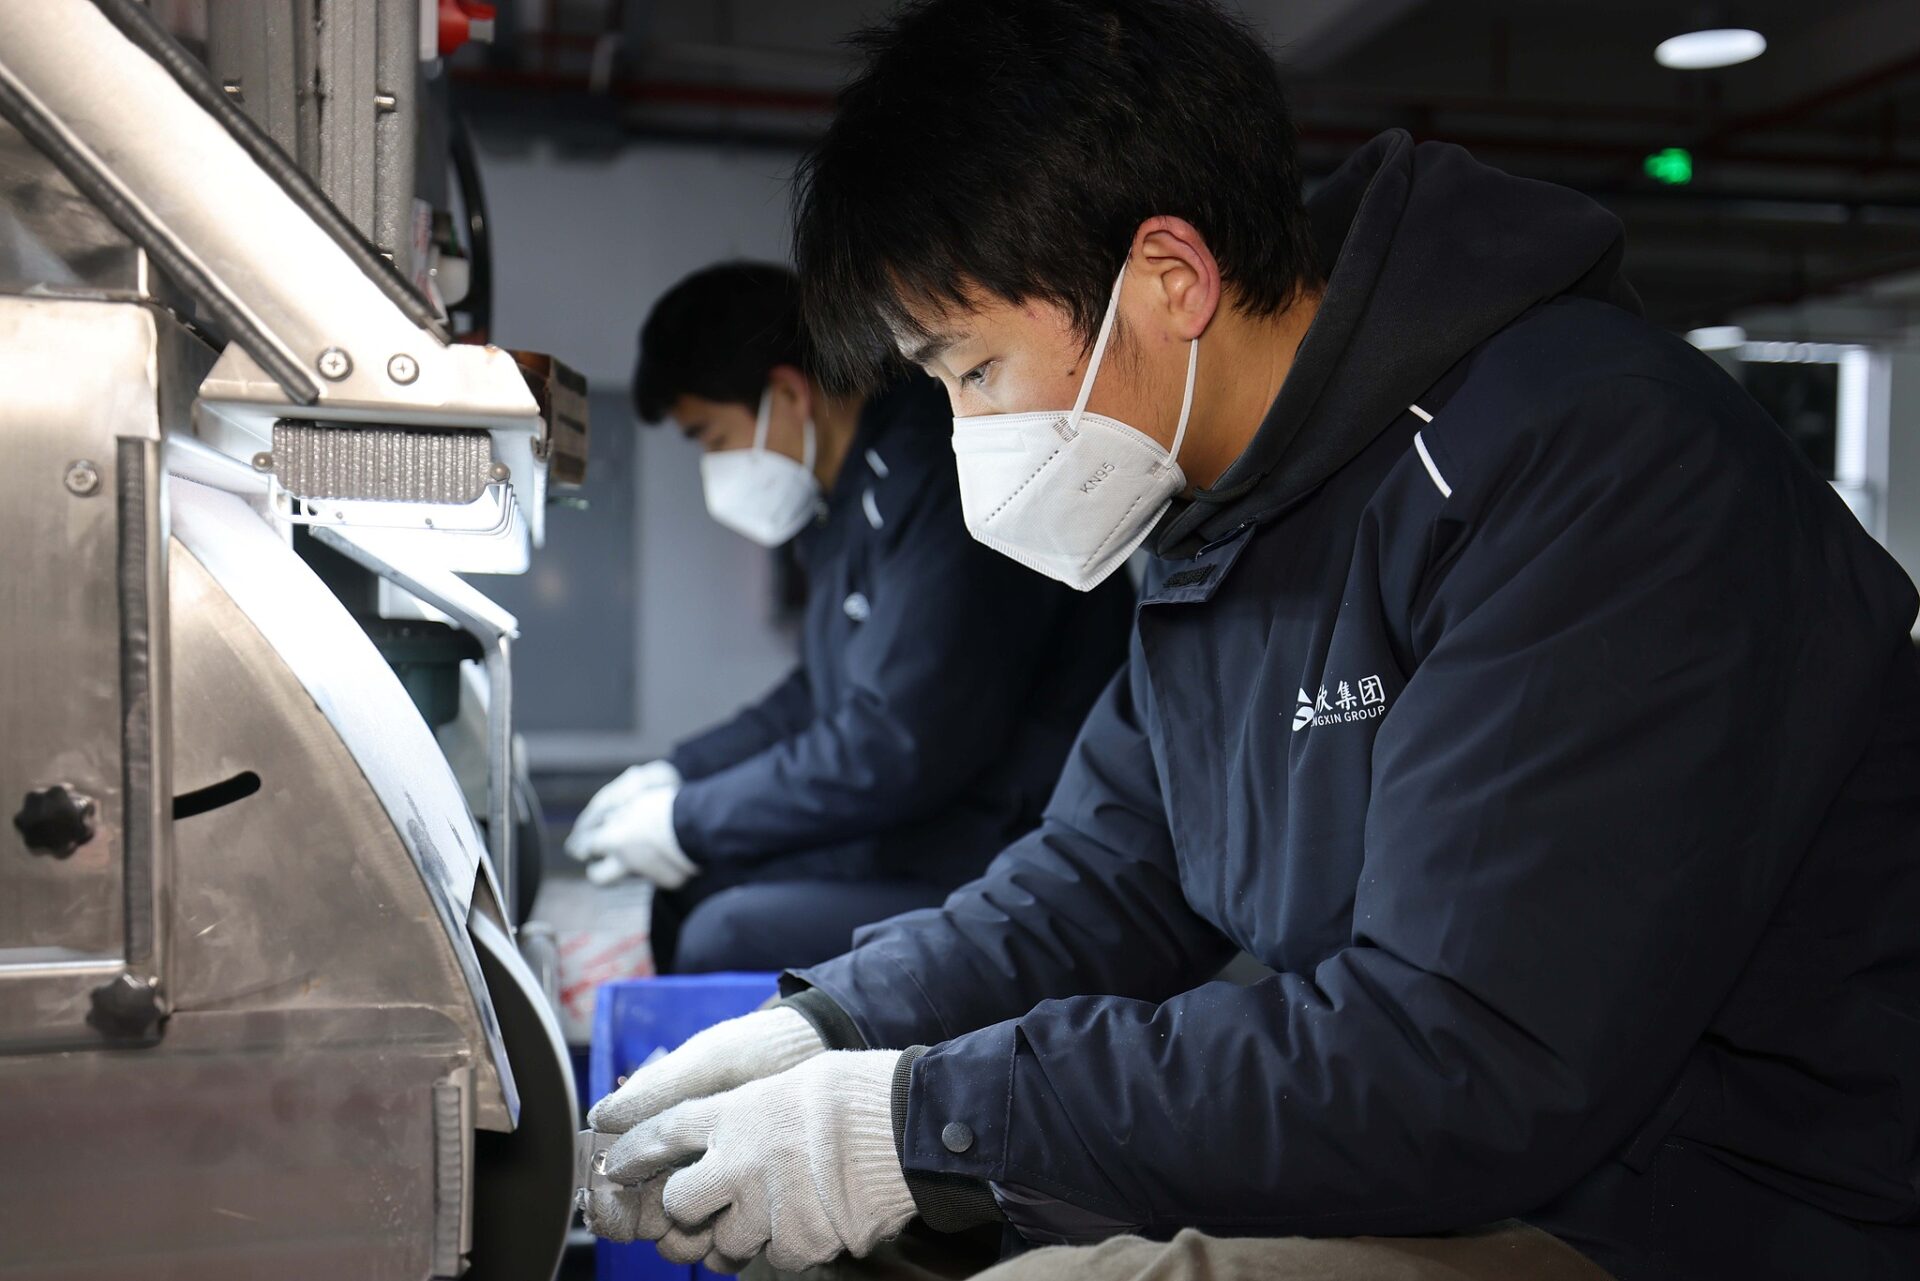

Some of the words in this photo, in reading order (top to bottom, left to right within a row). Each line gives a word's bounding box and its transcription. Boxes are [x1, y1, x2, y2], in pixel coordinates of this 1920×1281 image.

[1079, 462, 1115, 493] KN95
[1310, 713, 1342, 728] NGXIN
[1344, 704, 1386, 722] GROUP
